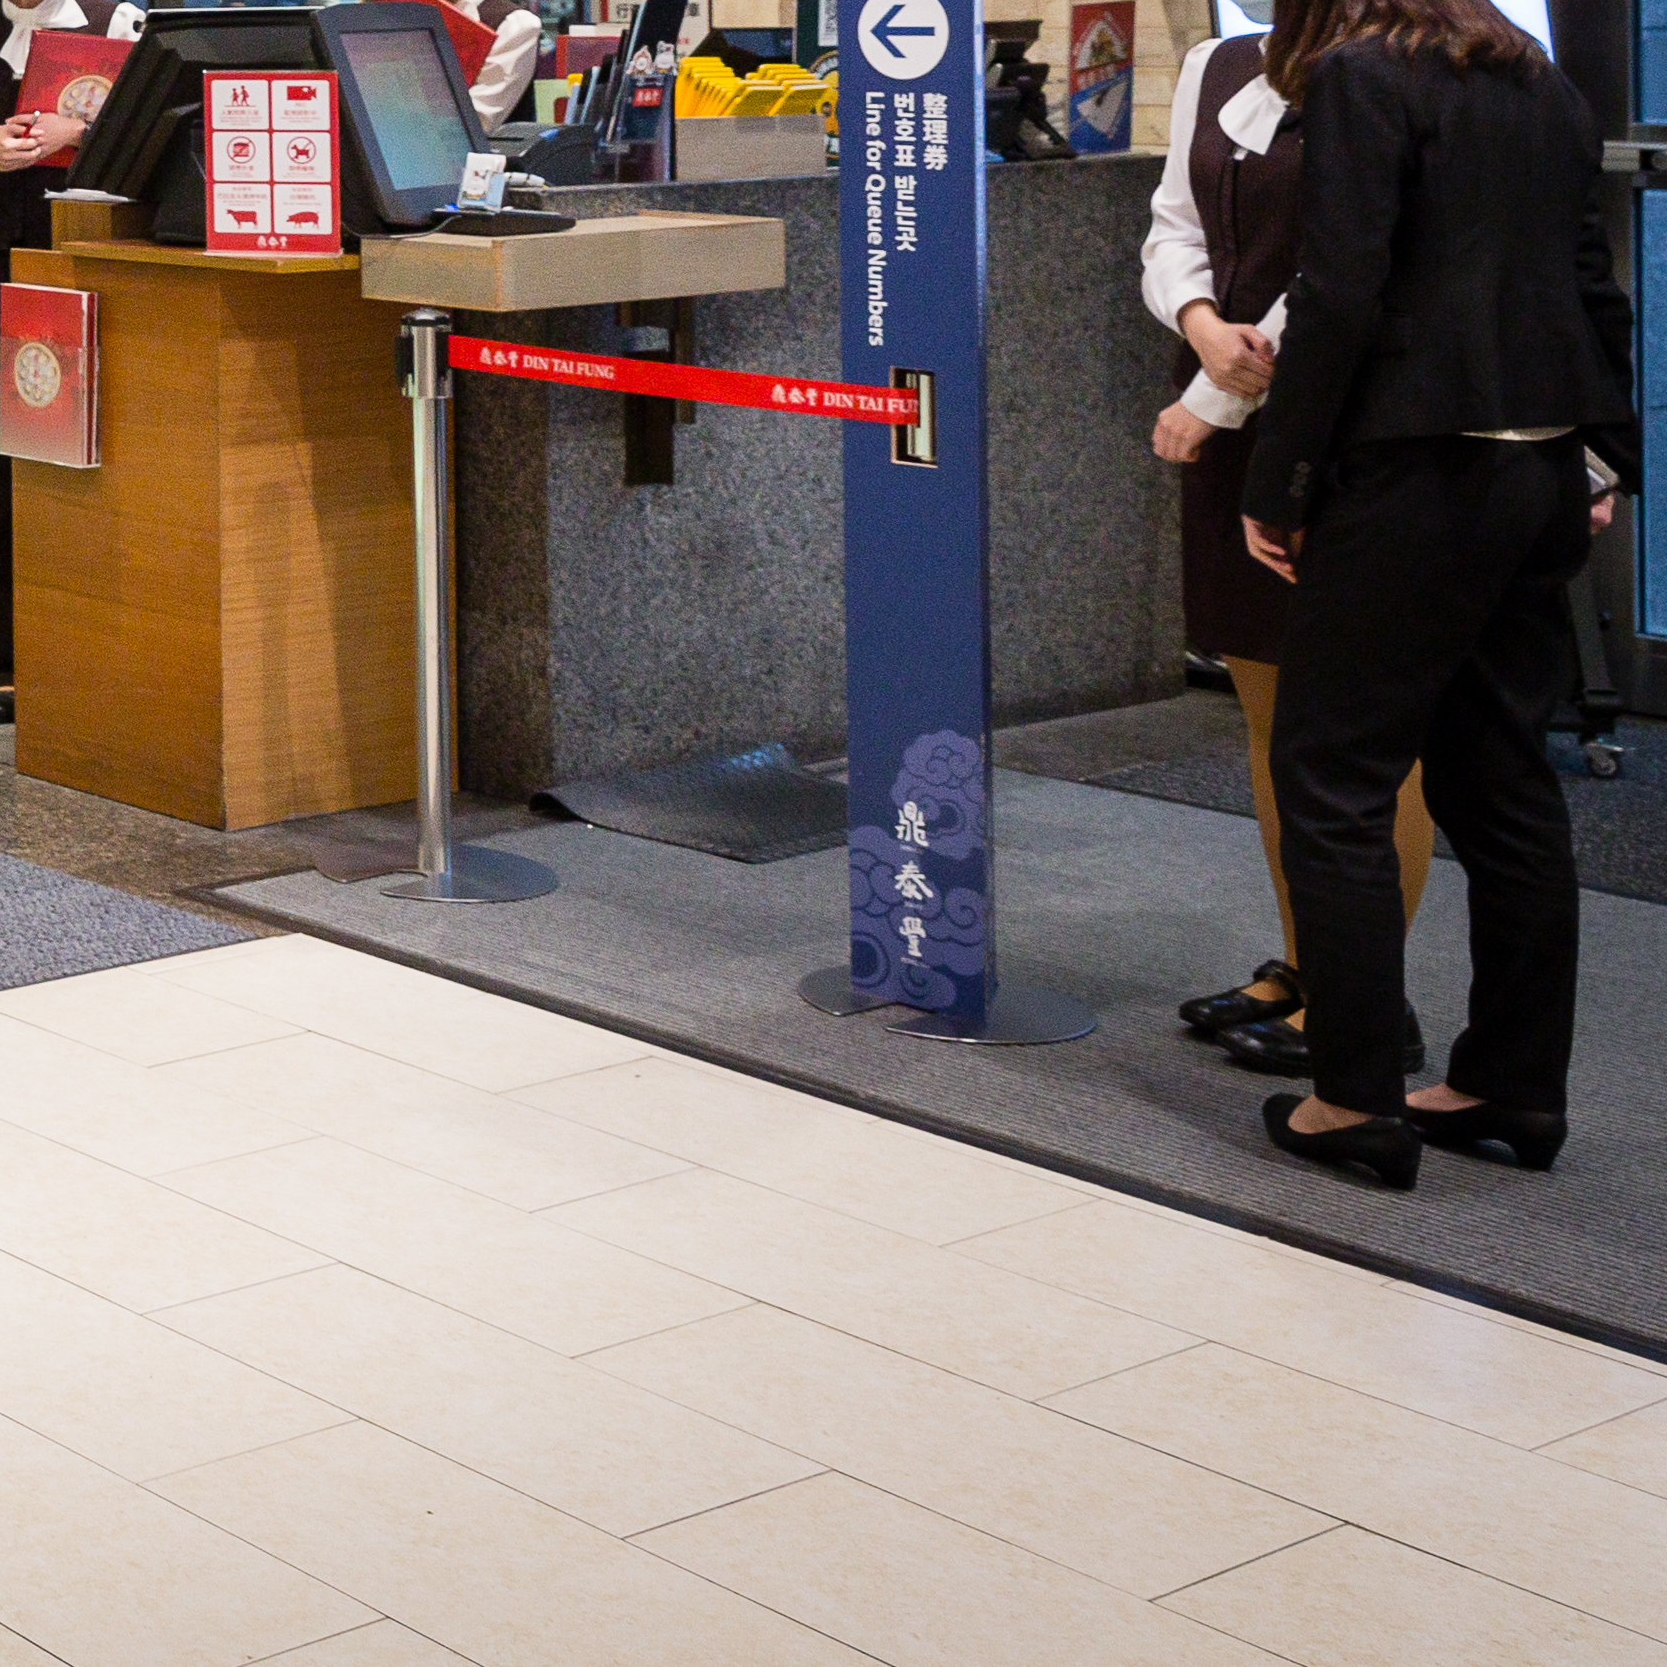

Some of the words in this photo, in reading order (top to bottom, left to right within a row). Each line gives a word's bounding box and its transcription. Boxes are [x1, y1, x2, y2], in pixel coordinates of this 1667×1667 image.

[866, 92, 885, 137] Line
[894, 93, 916, 167] 번호표
[923, 93, 948, 171] 整理券
[866, 140, 886, 171] for
[865, 174, 886, 245] Queue
[894, 175, 917, 251] 받는곳
[867, 249, 888, 347] Numbers
[479, 346, 518, 369] 鼎泰豐
[523, 354, 551, 371] DIN
[552, 358, 571, 374] TAI
[571, 361, 615, 380] FUNG
[771, 384, 818, 407] 鼎泰豐
[823, 391, 855, 409] DIN
[858, 395, 884, 413] TAI
[887, 397, 917, 415] FU
[895, 801, 934, 958] 鼎泰豐
